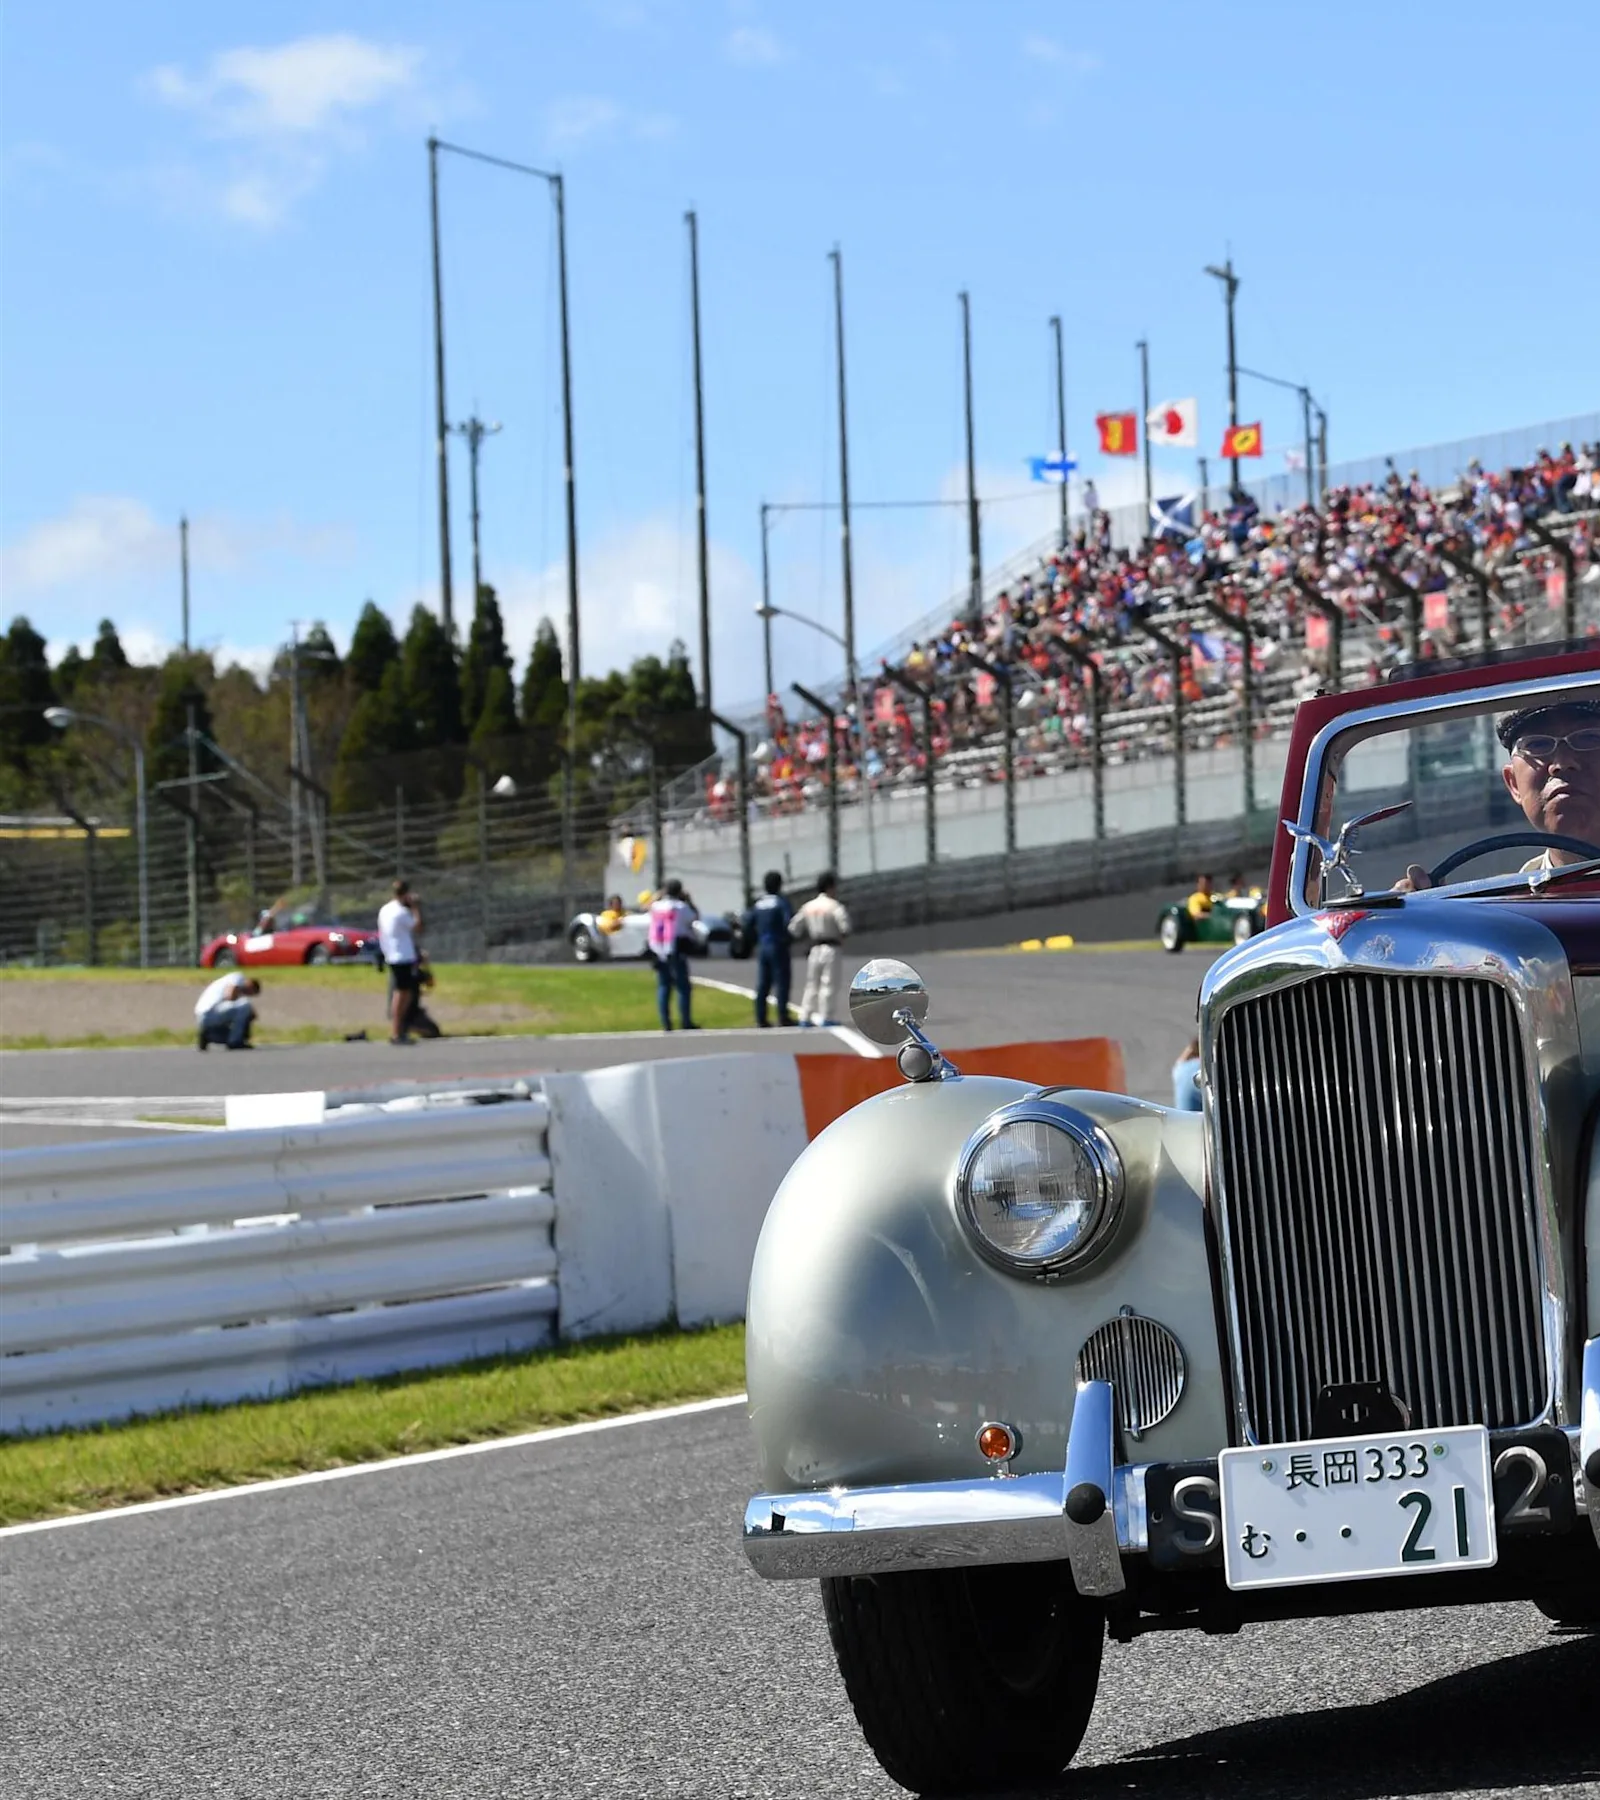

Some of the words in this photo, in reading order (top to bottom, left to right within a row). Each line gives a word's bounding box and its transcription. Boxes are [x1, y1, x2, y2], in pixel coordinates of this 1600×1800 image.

[1170, 1475, 1221, 1555] S
[1494, 1445, 1551, 1524] 2
[1397, 1486, 1471, 1563] 21
